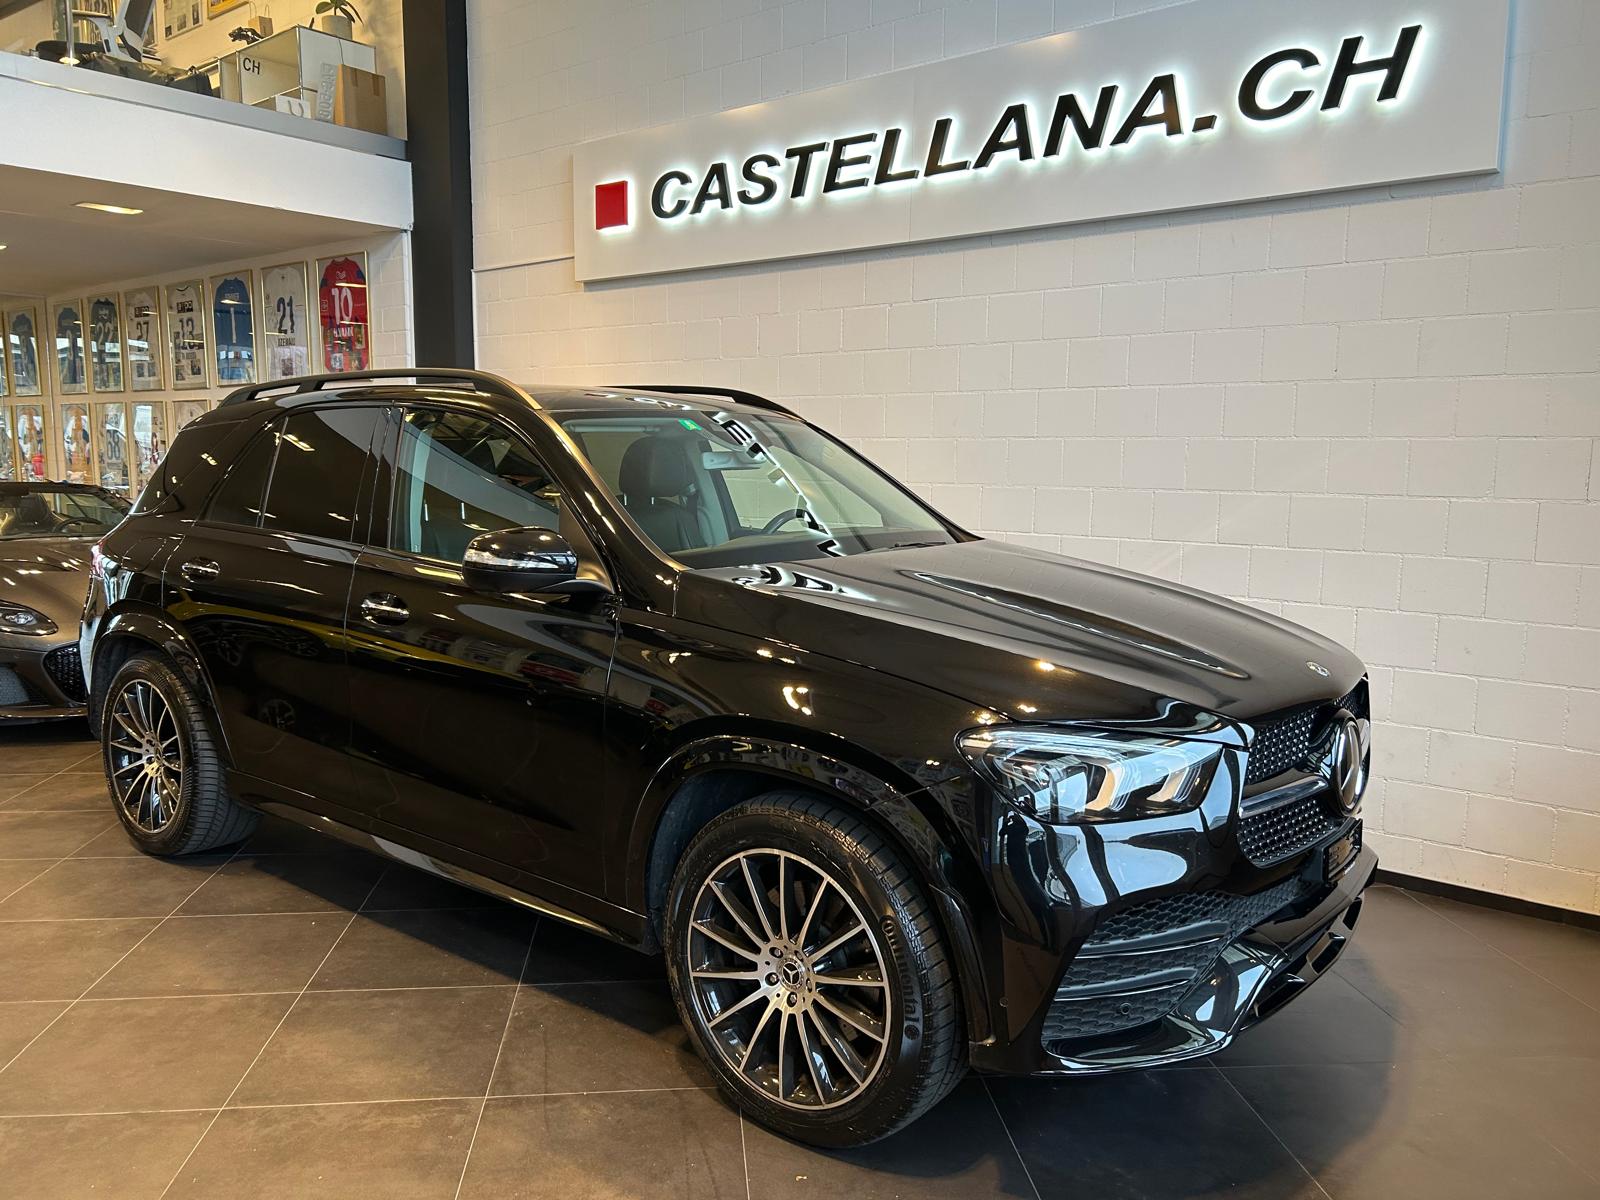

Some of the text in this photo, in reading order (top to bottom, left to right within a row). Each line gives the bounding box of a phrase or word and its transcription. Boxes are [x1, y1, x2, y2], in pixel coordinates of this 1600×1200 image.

[243, 57, 261, 75] CH
[276, 295, 295, 335] 21
[331, 287, 353, 325] 10
[230, 307, 237, 344] 1
